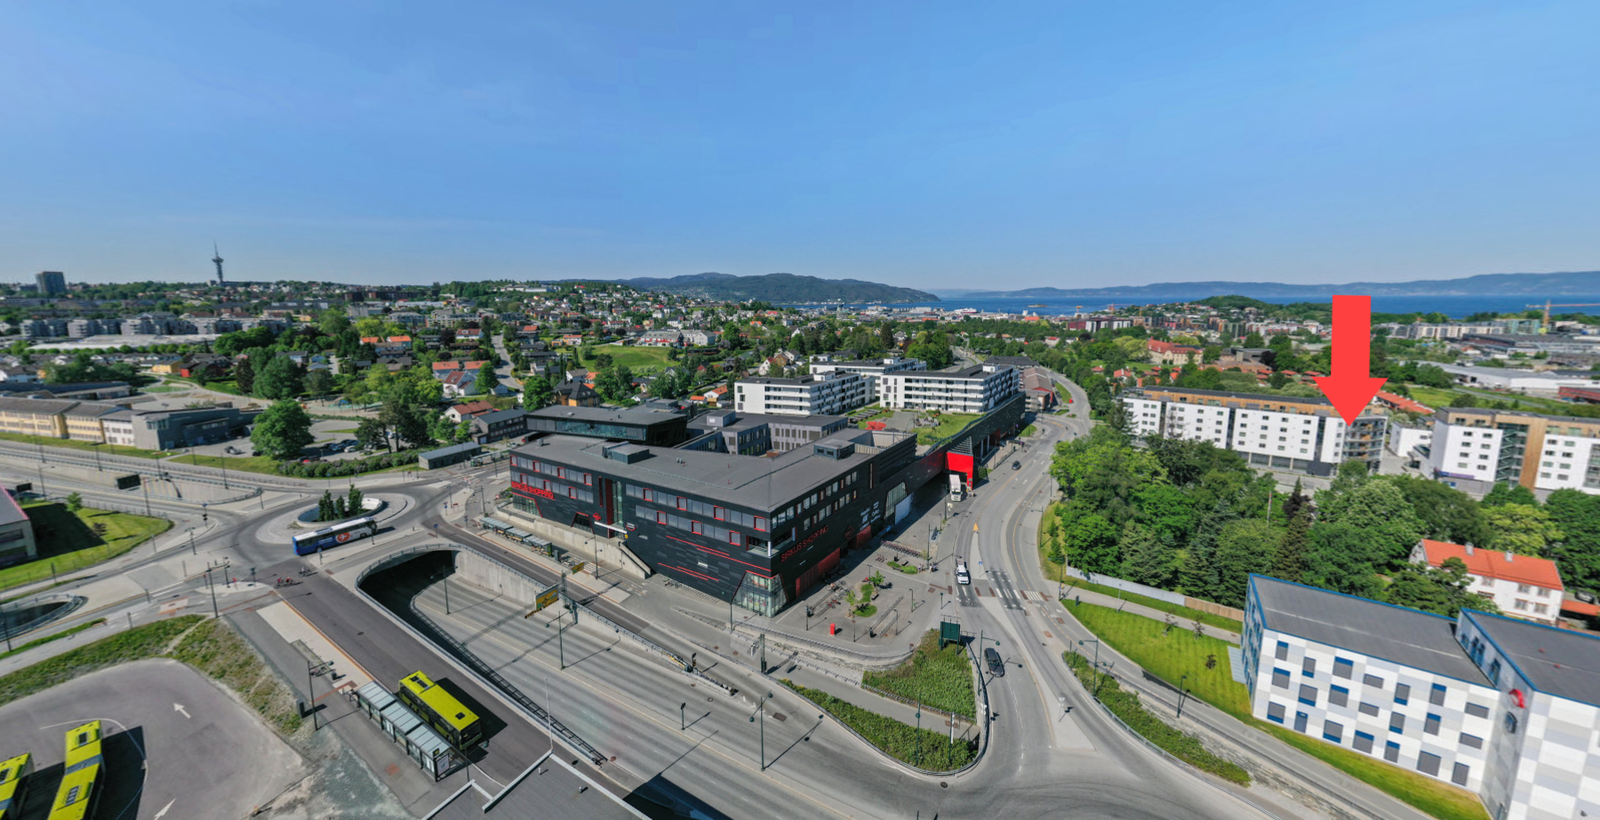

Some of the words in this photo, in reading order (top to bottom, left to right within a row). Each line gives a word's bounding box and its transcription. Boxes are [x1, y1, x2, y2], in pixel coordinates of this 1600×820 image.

[528, 485, 554, 499] SHOPPING
[781, 542, 802, 562] SIRKUS
[803, 525, 829, 548] SHOPPING
